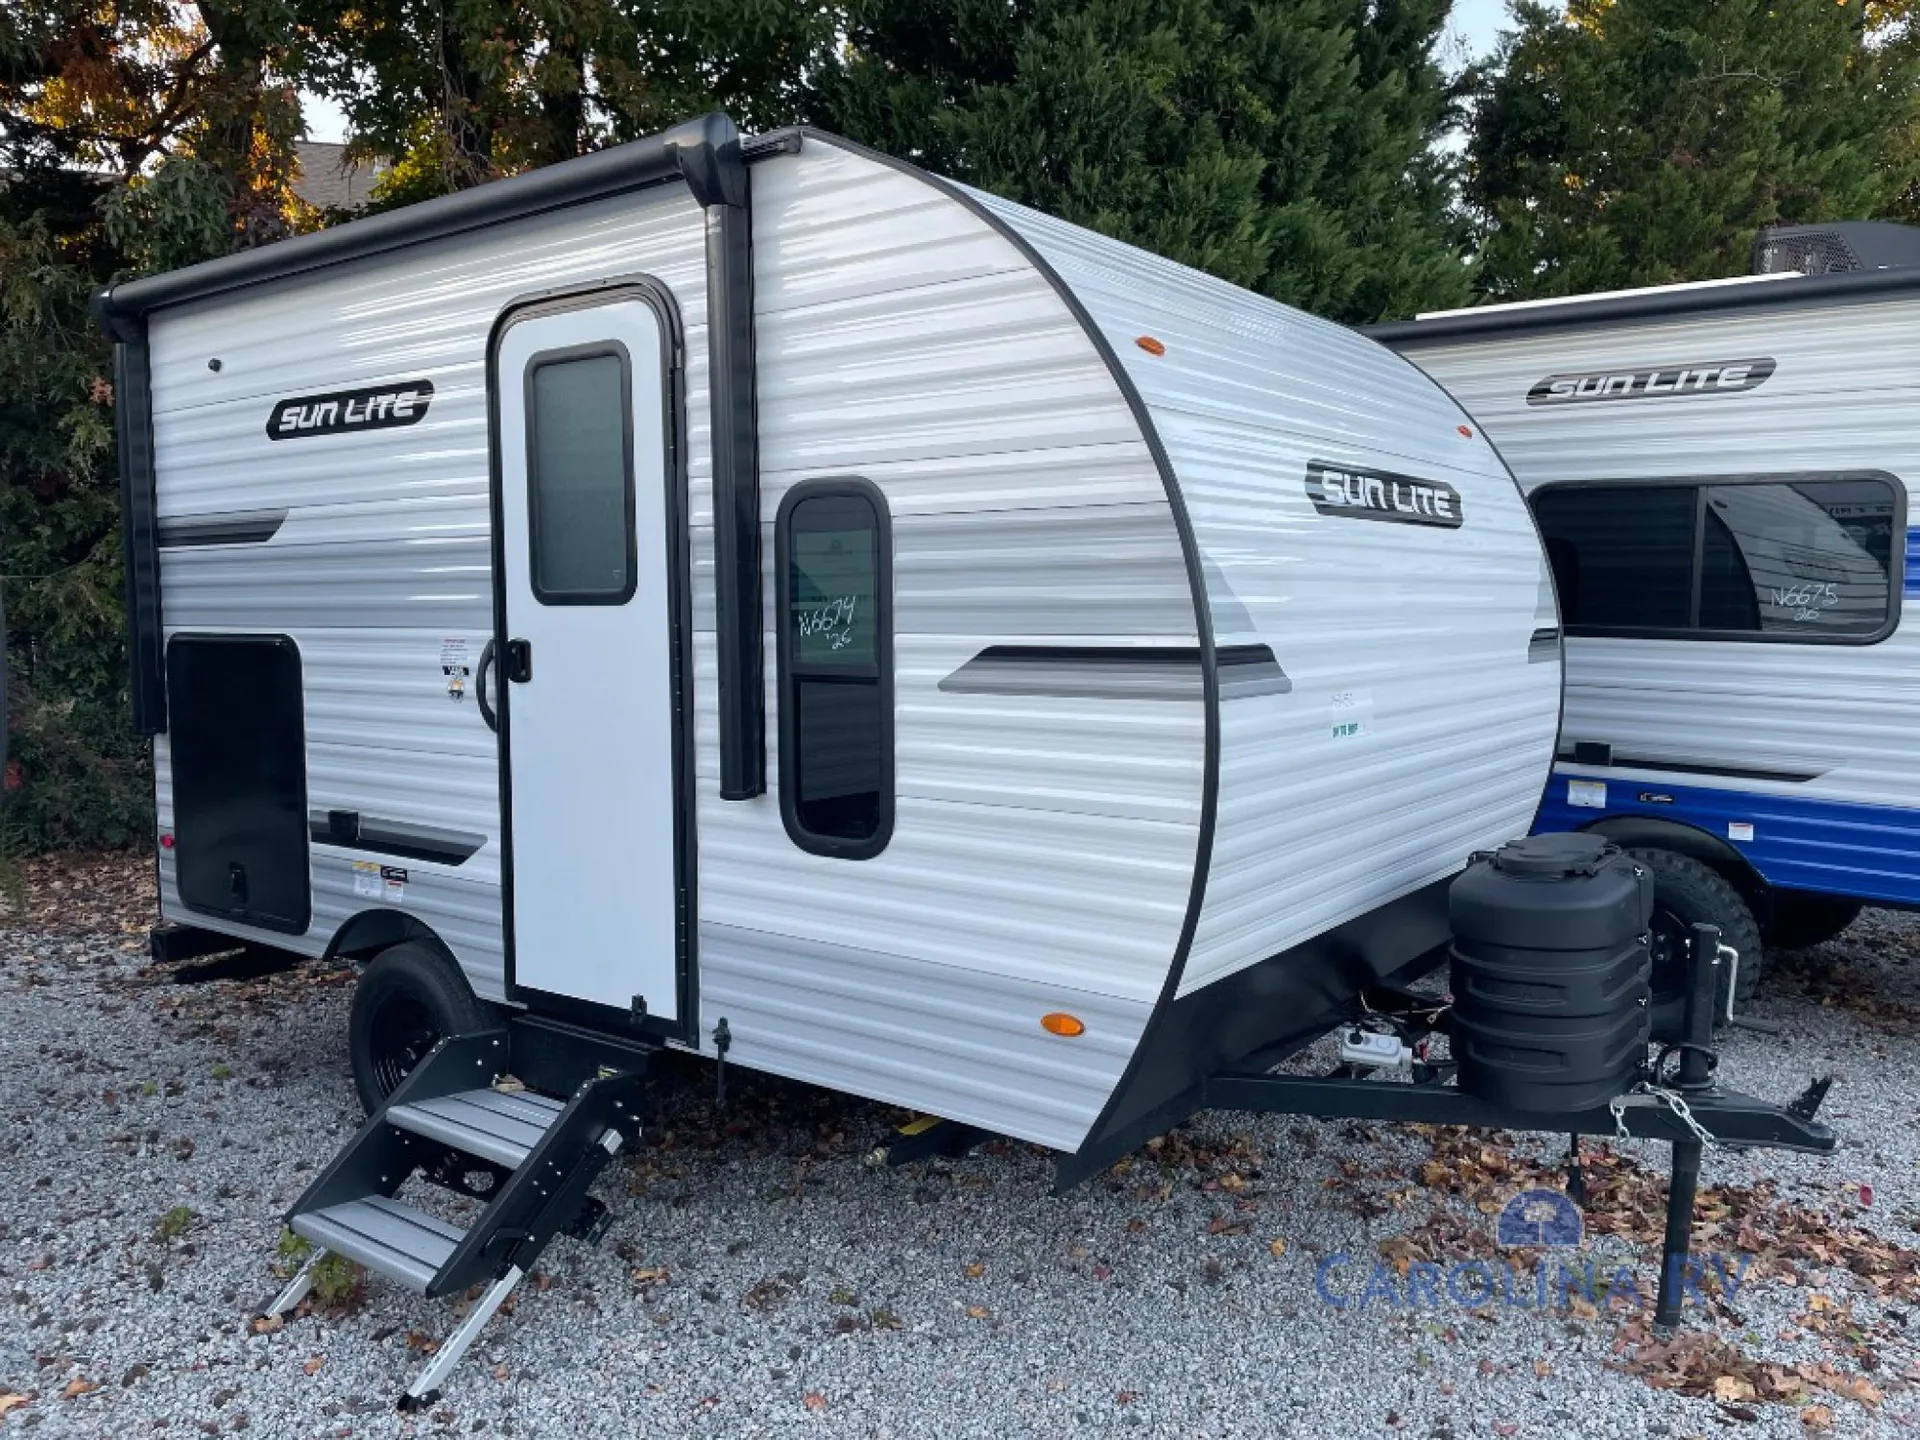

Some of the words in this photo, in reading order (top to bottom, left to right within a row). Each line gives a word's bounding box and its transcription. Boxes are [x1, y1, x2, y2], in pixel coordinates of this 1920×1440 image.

[1546, 374, 1635, 399] SUN
[1643, 365, 1753, 392] LITE
[279, 400, 338, 432] SUN
[344, 390, 420, 424] LITE
[1321, 469, 1388, 510] SUN
[1391, 481, 1454, 518] LITE
[1771, 583, 1838, 607] N6675
